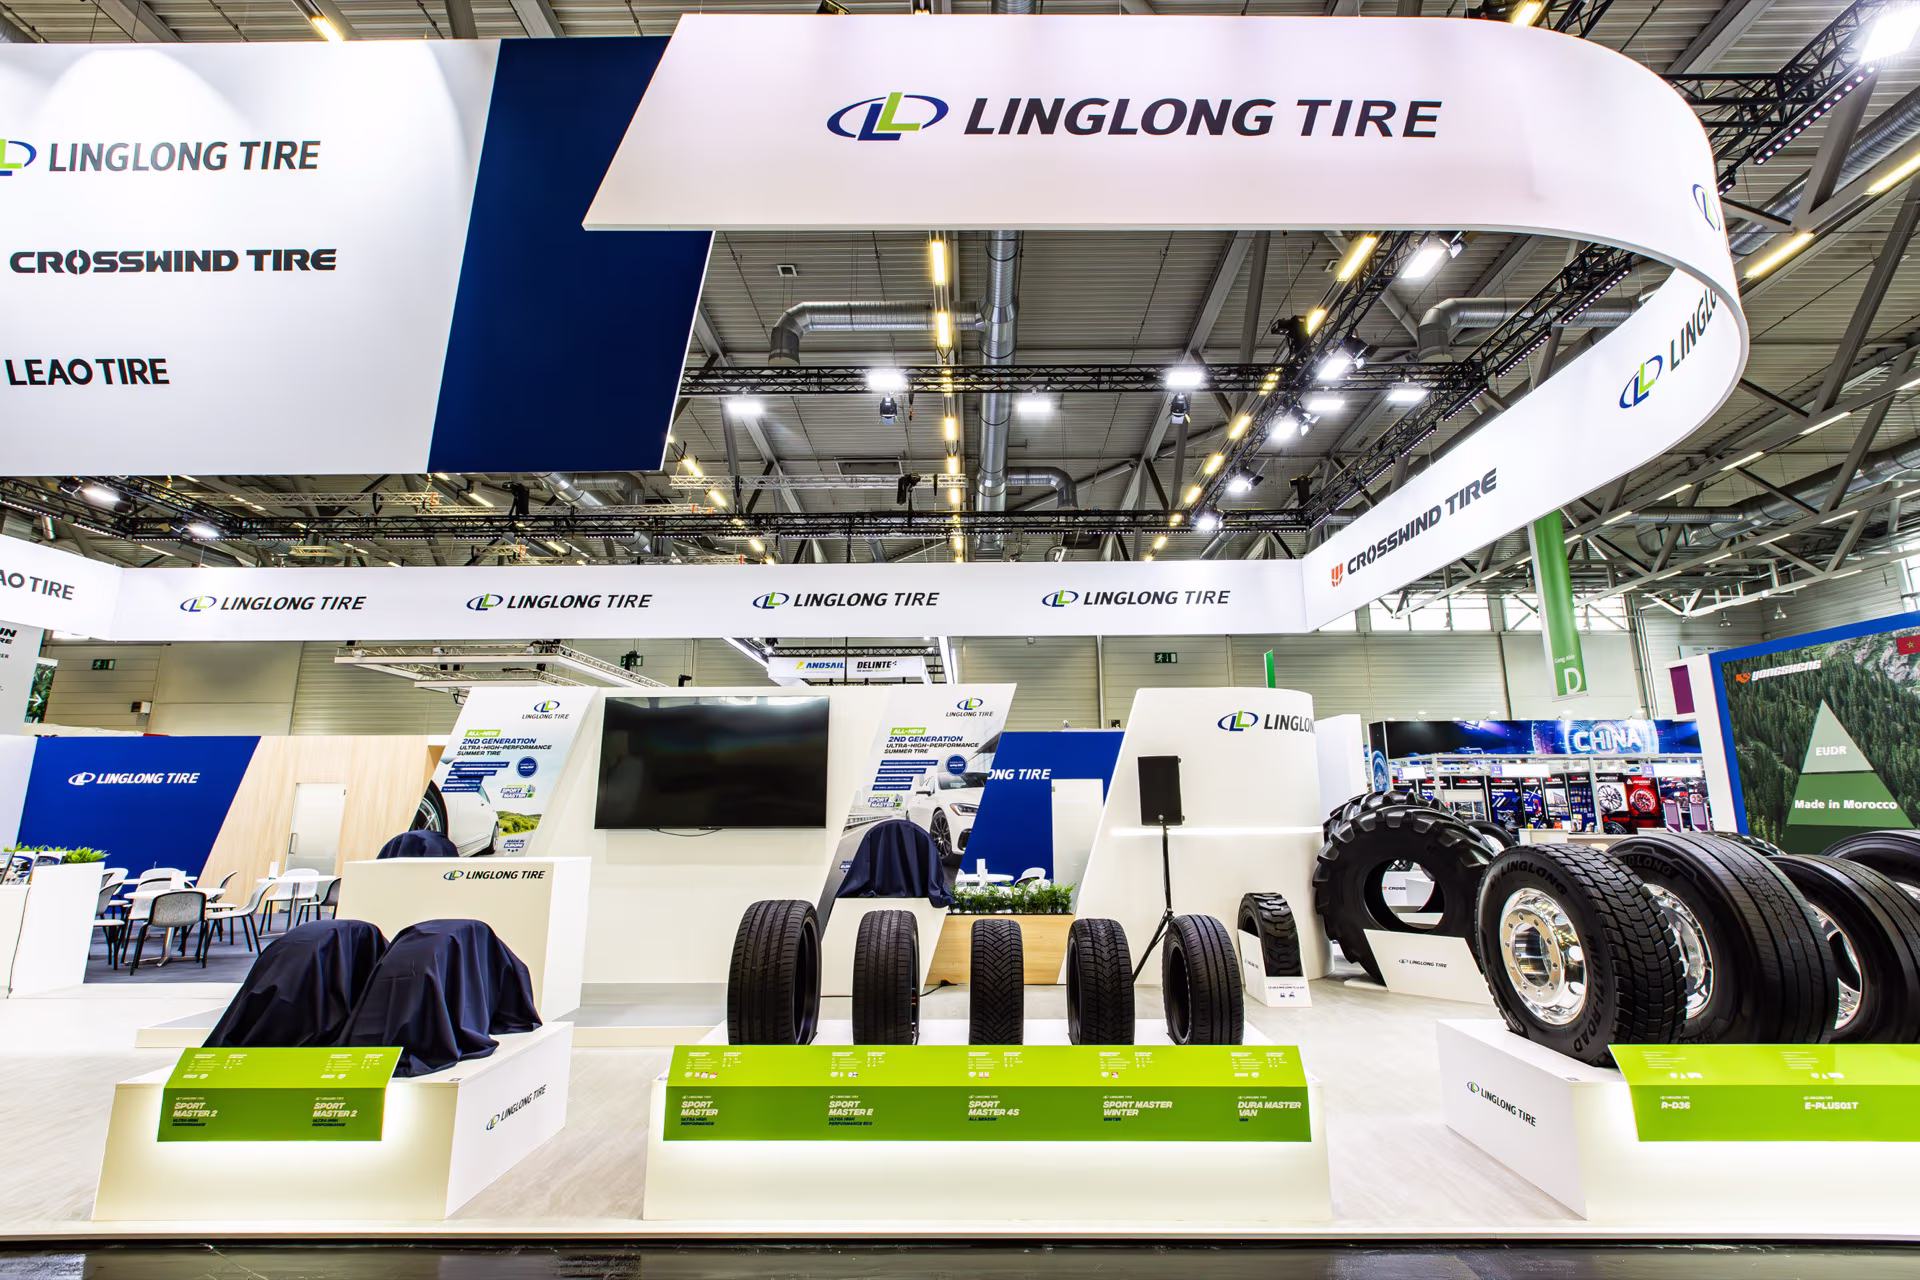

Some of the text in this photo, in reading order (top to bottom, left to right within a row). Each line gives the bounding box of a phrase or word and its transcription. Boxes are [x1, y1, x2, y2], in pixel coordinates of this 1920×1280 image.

[964, 97, 1443, 138] LINGLONG TIRE
[50, 140, 321, 172] LINGLONG TIRE
[10, 248, 337, 275] CROSSWIND TIRE
[5, 357, 170, 386] LEAO TIRE
[1347, 467, 1498, 576] CROSSWIND TIRE
[29, 576, 75, 600] TIRE
[220, 595, 367, 611] LINGLONG TIRE
[506, 594, 653, 609] LINGLONG TIRE
[793, 592, 940, 608] LINGLONG TIRE
[1083, 590, 1231, 606] LINGLONG TIRE
[857, 661, 892, 669] DELINTE
[1563, 667, 1582, 693] D
[1573, 729, 1642, 752] CHINA
[1815, 745, 1847, 756] EUDR
[96, 772, 200, 785] LINGLONG TIRE
[1018, 768, 1052, 780] TIRE
[1794, 798, 1898, 810] Made in Morocco
[465, 870, 545, 880] LINGLONG TIRE
[1500, 859, 1567, 895] LINGLONG
[174, 1102, 206, 1110] SPORT
[313, 1102, 345, 1110] SPORT
[500, 1084, 547, 1122] LINGLONG TIRE
[1237, 1101, 1302, 1109] DURA MASTER
[1480, 1087, 1537, 1127] LINGLONG TIRE
[1661, 1101, 1691, 1109] R-D36
[680, 1108, 718, 1116] MASTER
[828, 1108, 874, 1116] MASTER E
[968, 1108, 1020, 1116] MASTER 4S
[1103, 1108, 1139, 1116] WINTER
[1238, 1109, 1258, 1117] VAN
